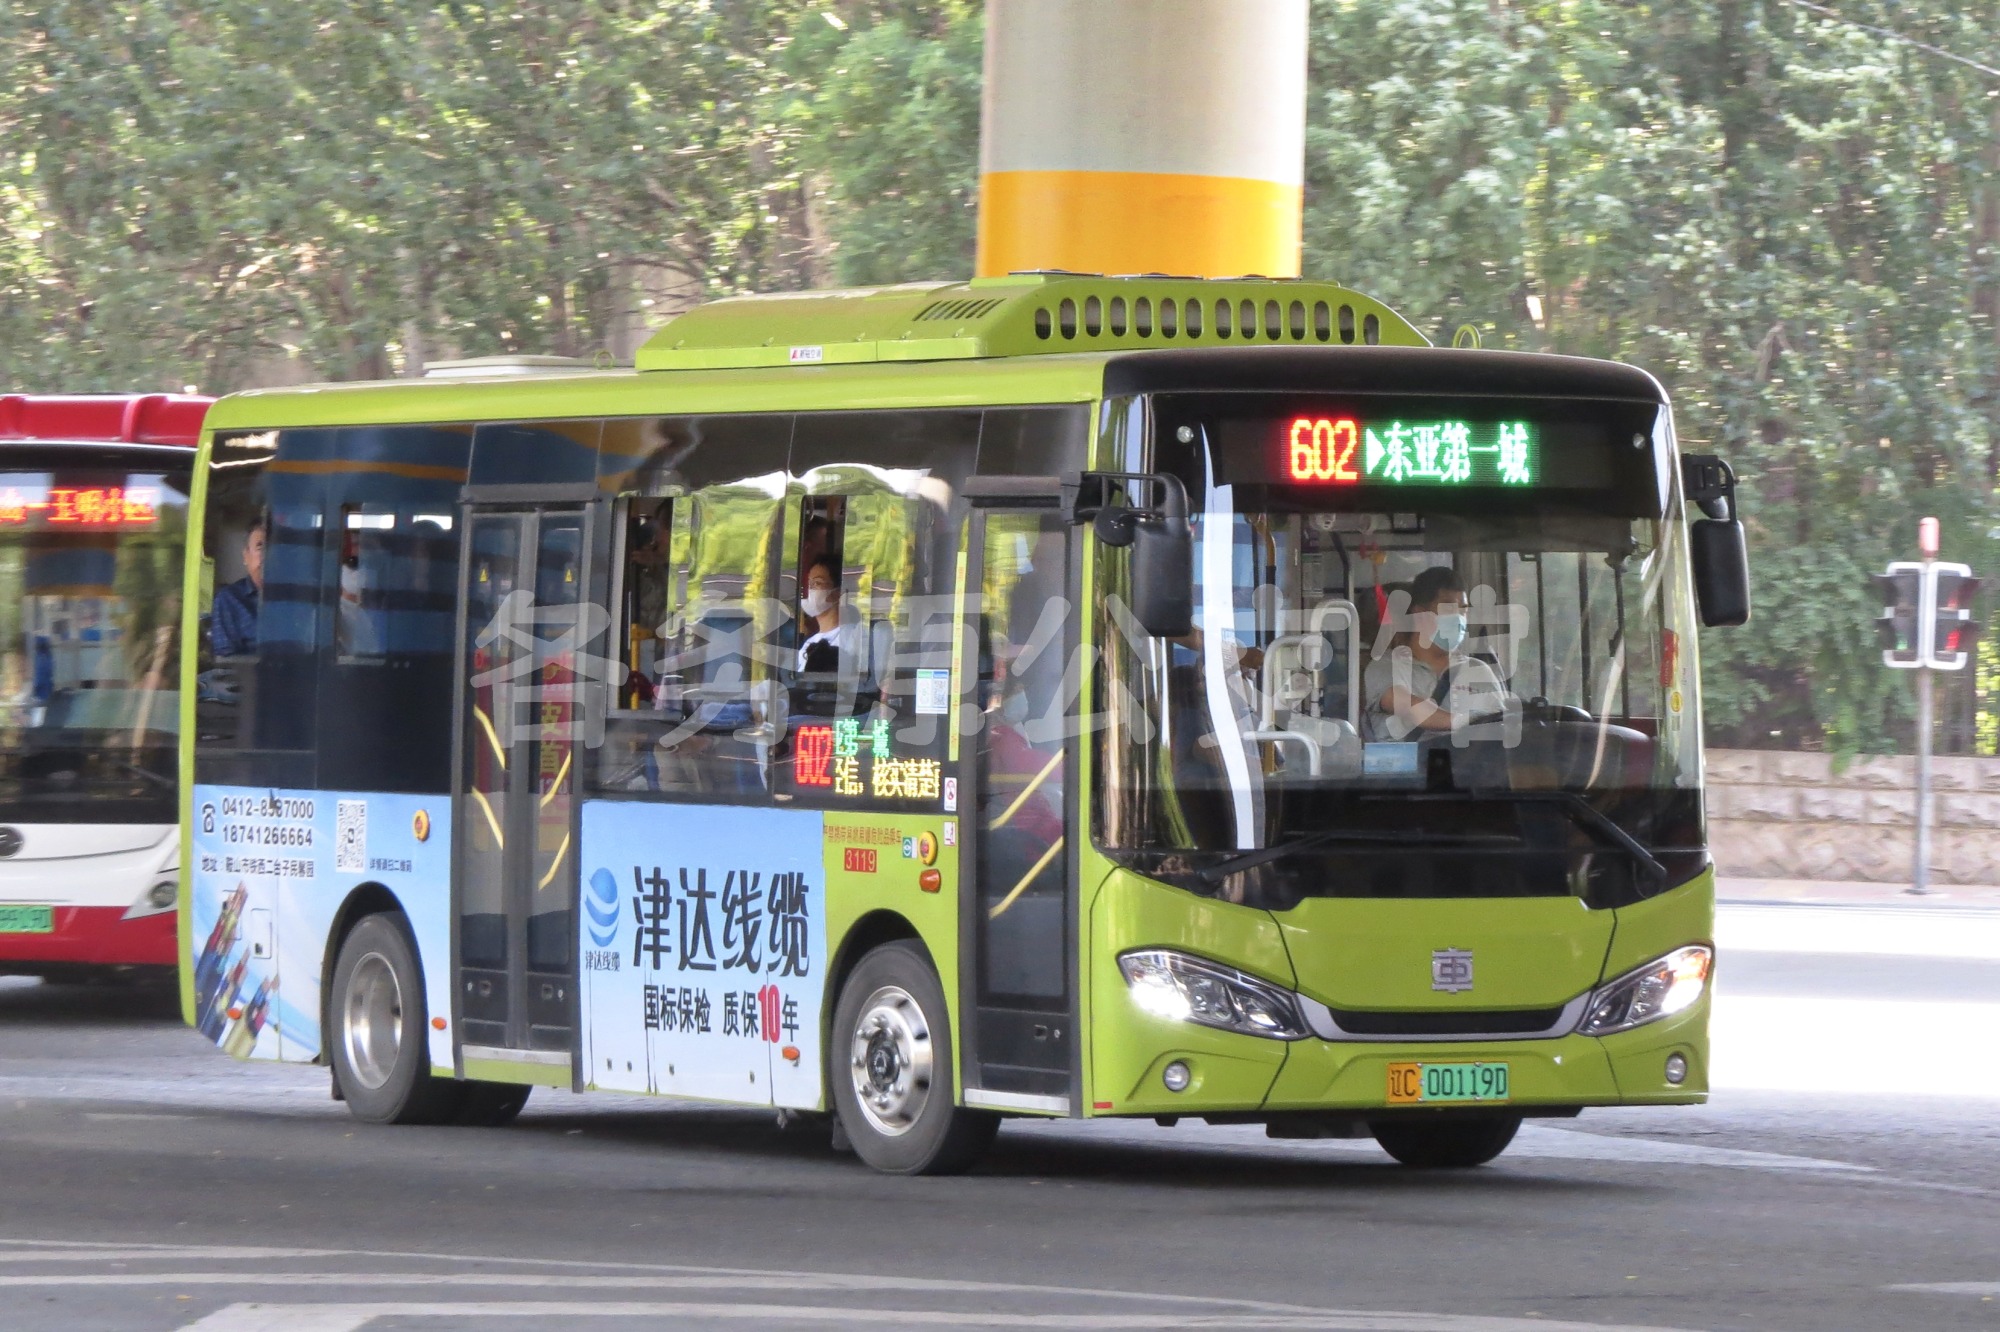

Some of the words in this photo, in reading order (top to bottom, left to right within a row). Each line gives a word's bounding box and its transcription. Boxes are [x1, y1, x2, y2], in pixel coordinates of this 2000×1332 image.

[1289, 418, 1359, 480] 602
[1382, 420, 1531, 484] 东亚第一城
[796, 725, 833, 785] 602
[223, 824, 313, 846] 18741266664
[845, 849, 876, 872] 3119
[632, 865, 810, 978] 津达线缆
[585, 950, 621, 972] 津达线缆
[644, 983, 712, 1035] 国标保检
[722, 983, 800, 1044] 质保10年
